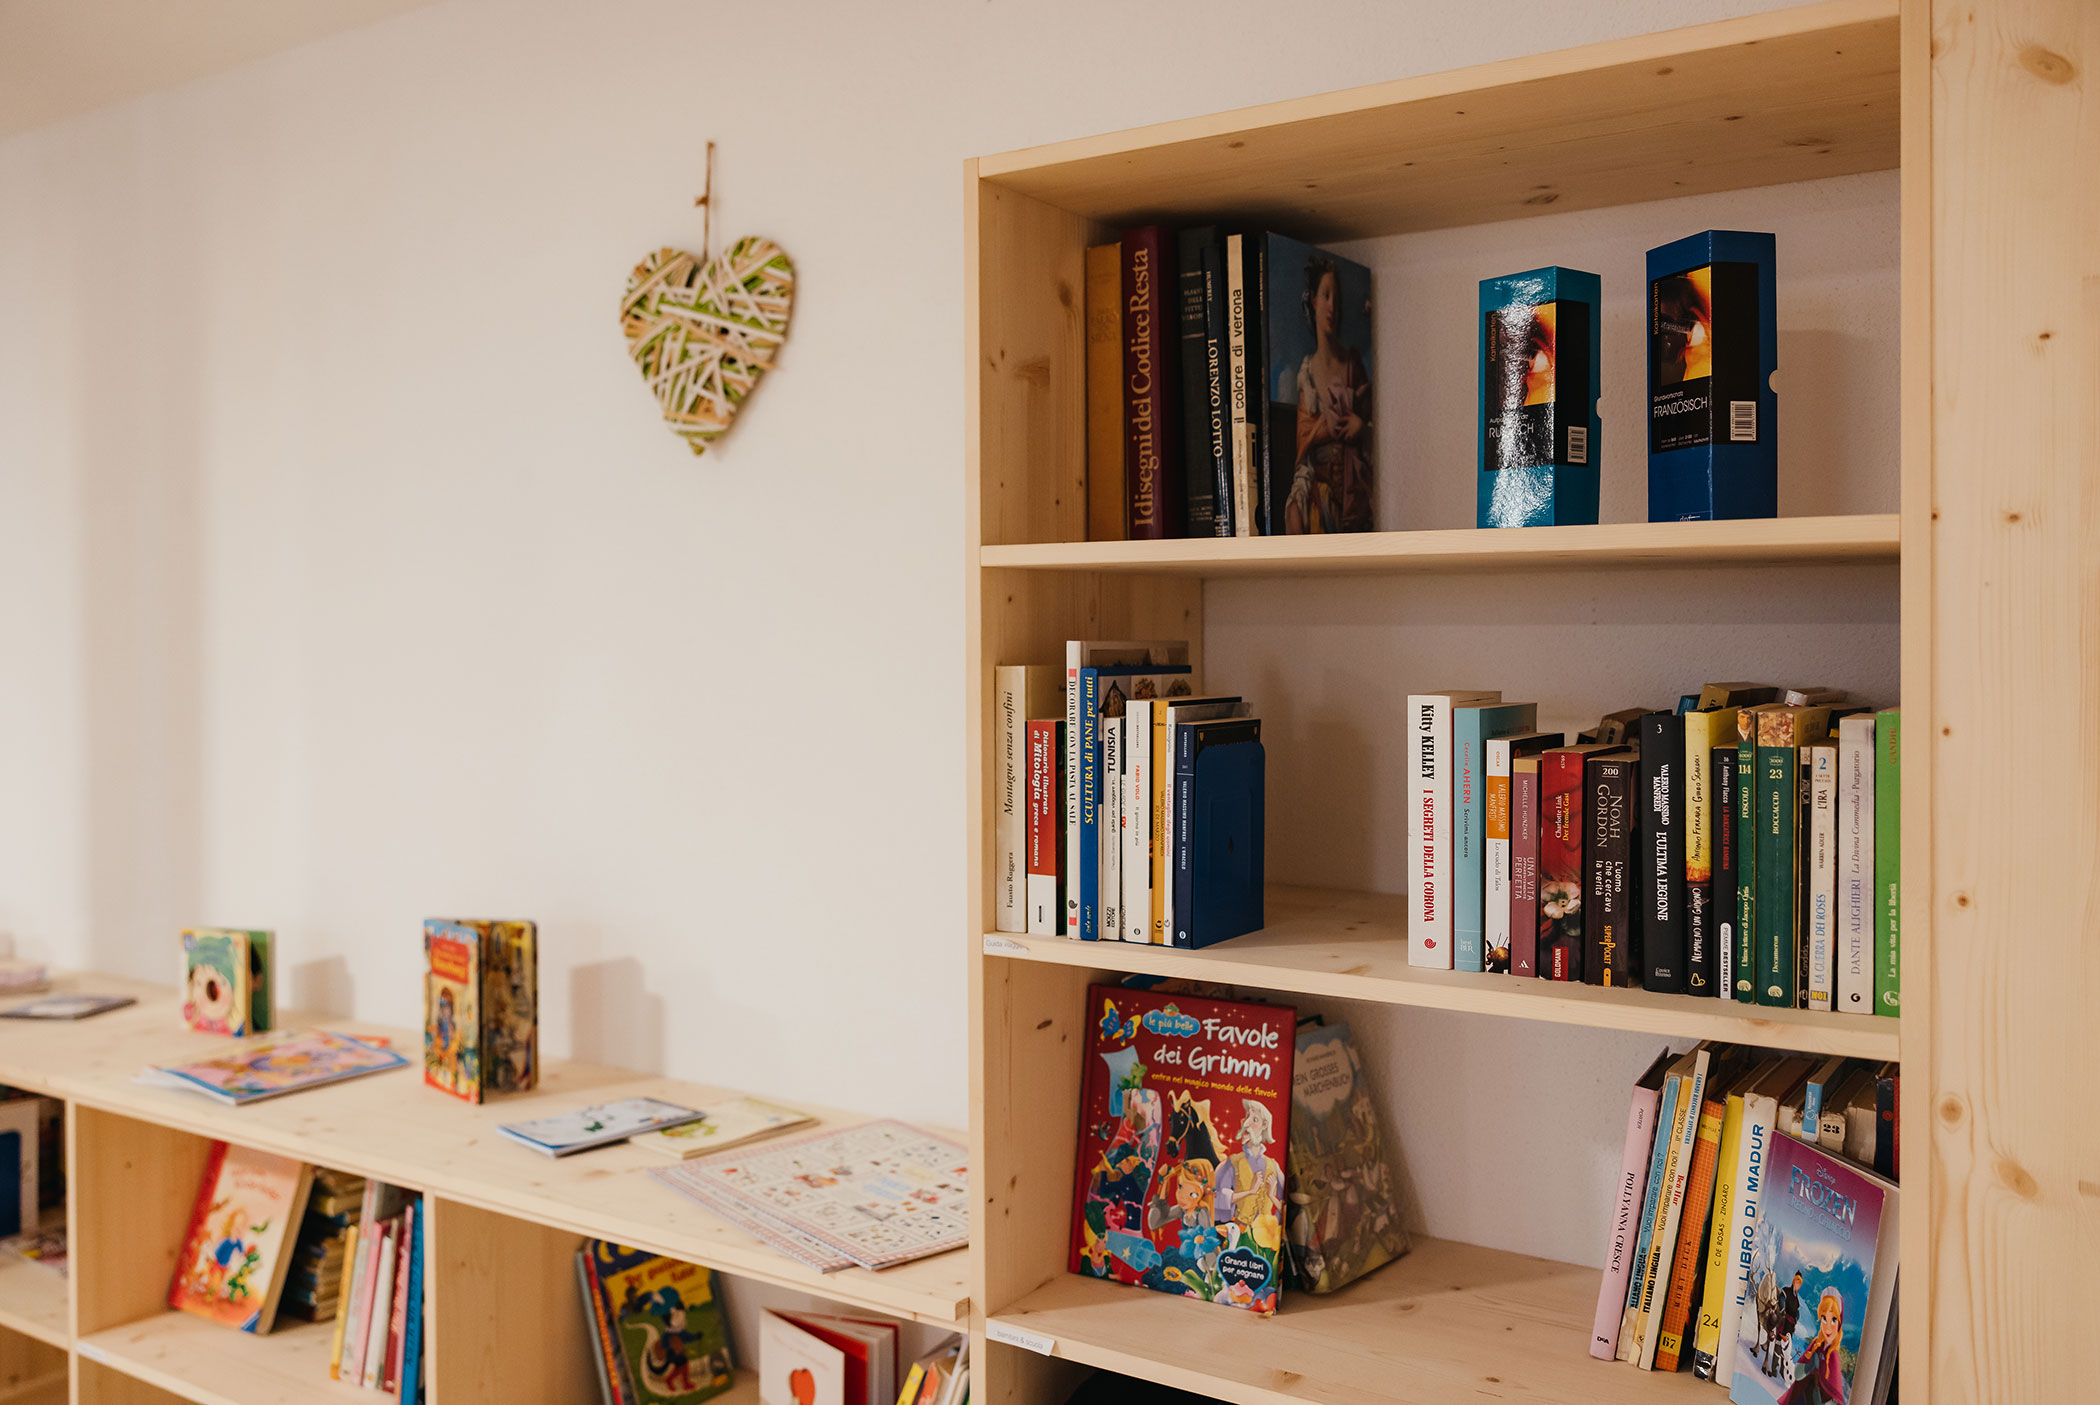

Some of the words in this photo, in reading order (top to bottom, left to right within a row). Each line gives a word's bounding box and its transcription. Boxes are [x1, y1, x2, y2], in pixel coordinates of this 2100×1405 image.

[1129, 247, 1151, 315] Resta
[1232, 288, 1243, 338] verona
[1131, 314, 1152, 395] Codice
[1232, 344, 1243, 357] di
[1207, 338, 1221, 408] LORENZO
[1232, 364, 1245, 409] colore
[1132, 397, 1153, 431] del
[1233, 416, 1245, 424] il
[1653, 396, 1708, 419] FRANZÖSISCH
[1211, 409, 1224, 457] LOTTO
[1132, 432, 1160, 518] disegni
[1084, 676, 1094, 695] tutti
[1003, 690, 1016, 729] confini
[1068, 680, 1076, 727] DECORARE
[1086, 695, 1096, 718] per
[1418, 704, 1435, 733] Kitty
[1656, 723, 1663, 734] 3
[1006, 731, 1014, 760] senza
[1033, 729, 1041, 739] di
[1068, 730, 1076, 750] CON
[1084, 718, 1094, 750] PANE
[1068, 751, 1076, 762] LA
[1084, 752, 1094, 763] di
[1107, 726, 1116, 774] TUNISIA
[1421, 735, 1435, 780] KELLEY
[1819, 757, 1827, 770] 2
[1031, 742, 1043, 801] Mitologia
[1068, 766, 1076, 789] PASTA
[1602, 767, 1619, 776] 200
[1660, 764, 1670, 794] VALERIO
[1722, 765, 1730, 790] Anthony
[1738, 764, 1752, 775] 114
[1769, 769, 1783, 780] 23
[1851, 750, 1864, 790] Purgatorio
[1003, 763, 1016, 816] Montagne
[1068, 790, 1076, 802] AL
[1084, 765, 1094, 825] SCULTURA
[1463, 768, 1471, 804] AHERN
[1498, 783, 1507, 806] VALERIO
[1521, 779, 1529, 809] MICHELLE
[1562, 792, 1570, 807] Gast
[1653, 776, 1661, 812] MANFREDI
[1722, 787, 1730, 804] Flacco
[1817, 788, 1828, 810] L'IRA
[1032, 800, 1040, 826] greca
[1068, 805, 1077, 826] SALE
[1488, 792, 1497, 822] MANFREDI
[1597, 784, 1611, 848] GORDON
[1661, 794, 1670, 826] MASSIMO
[1741, 786, 1750, 819] FOSCOLO
[1772, 791, 1780, 835] BOCCACCIO
[1851, 795, 1860, 834] Commedia
[1422, 797, 1435, 842] SEGRETI
[1463, 808, 1471, 836] Scrivimi
[1498, 806, 1507, 832] MASSIMO
[1521, 810, 1529, 840] HUNZIKER
[1555, 810, 1563, 838] Charlotte
[1562, 808, 1570, 829] fremde
[1609, 795, 1623, 839] NOAH
[1562, 829, 1570, 841] Der
[1851, 836, 1860, 862] Divina
[1006, 851, 1016, 882] Ruggera
[1423, 845, 1435, 879] DELLA
[1526, 856, 1535, 877] UNA
[1596, 860, 1603, 868] la
[1655, 831, 1668, 876] L'ULTIMA
[1514, 856, 1523, 900] PERFETTA
[1595, 868, 1603, 896] verità
[1605, 860, 1613, 877] che
[1614, 861, 1623, 893] L'uomo
[1851, 864, 1860, 874] La
[1006, 883, 1014, 909] Fausto
[1423, 881, 1435, 923] CORONA
[1526, 880, 1536, 901] VITA
[1604, 877, 1612, 913] cercava
[1657, 878, 1669, 922] LEGIONE
[1692, 887, 1702, 915] GIORNO
[1888, 883, 1897, 907] libertà
[1815, 893, 1826, 921] ROSES
[1850, 879, 1861, 933] ALIGHIERI
[1888, 908, 1897, 917] la
[1815, 922, 1825, 937] DEI
[1889, 918, 1898, 932] per
[1691, 926, 1702, 963] NEMMENO
[1771, 935, 1779, 973] Decameron
[1888, 933, 1897, 948] vita
[1554, 948, 1562, 978] GOLDMANN
[1814, 938, 1825, 972] GUERRA
[1850, 936, 1861, 975] DANTE
[1888, 949, 1897, 964] mia
[1814, 972, 1825, 984] LA
[1888, 967, 1897, 978] La
[1148, 1017, 1156, 1026] le
[1158, 1019, 1172, 1032] più
[1174, 1020, 1194, 1032] belle
[1202, 1018, 1279, 1049] Favole
[1153, 1043, 1182, 1065] dei
[1187, 1046, 1272, 1081] Grimm
[1309, 1061, 1340, 1082] GROSSES
[1151, 1072, 1171, 1082] entra
[1172, 1074, 1183, 1084] nel
[1184, 1077, 1209, 1090] magico
[1210, 1082, 1235, 1092] mondo
[1235, 1084, 1253, 1096] delle
[1253, 1087, 1278, 1099] favole
[1637, 1107, 1645, 1130] PORTER
[1675, 1107, 1687, 1135] CLASSE
[1822, 1122, 1840, 1135] 23
[1746, 1123, 1764, 1193] MADUR
[1650, 1169, 1661, 1185] con
[1666, 1168, 1676, 1184] con
[1676, 1174, 1685, 1190] Ben
[1815, 1161, 1836, 1185] Disney
[1617, 1171, 1635, 1232] POLLYANNA
[1646, 1185, 1661, 1217] imparare
[1660, 1184, 1675, 1216] imparare
[1672, 1189, 1683, 1206] Hur
[1719, 1183, 1730, 1216] ZINGARO
[1744, 1199, 1757, 1218] DI
[1788, 1163, 1857, 1230] FROZEN
[1643, 1216, 1655, 1233] Vuoi
[1657, 1215, 1669, 1232] Vuoi
[1716, 1222, 1725, 1247] ROSAS
[1224, 1255, 1248, 1268] Grandi
[1248, 1260, 1264, 1271] libri
[1610, 1233, 1625, 1274] CRESCE
[1715, 1247, 1722, 1259] DE
[1738, 1224, 1755, 1284] LIBRO
[1222, 1266, 1236, 1274] per
[1236, 1268, 1265, 1280] sognare
[1642, 1279, 1656, 1313] ITALIANO
[1649, 1251, 1662, 1280] LINGUA
[1702, 1313, 1719, 1329] 24
[1662, 1336, 1678, 1350] 67
